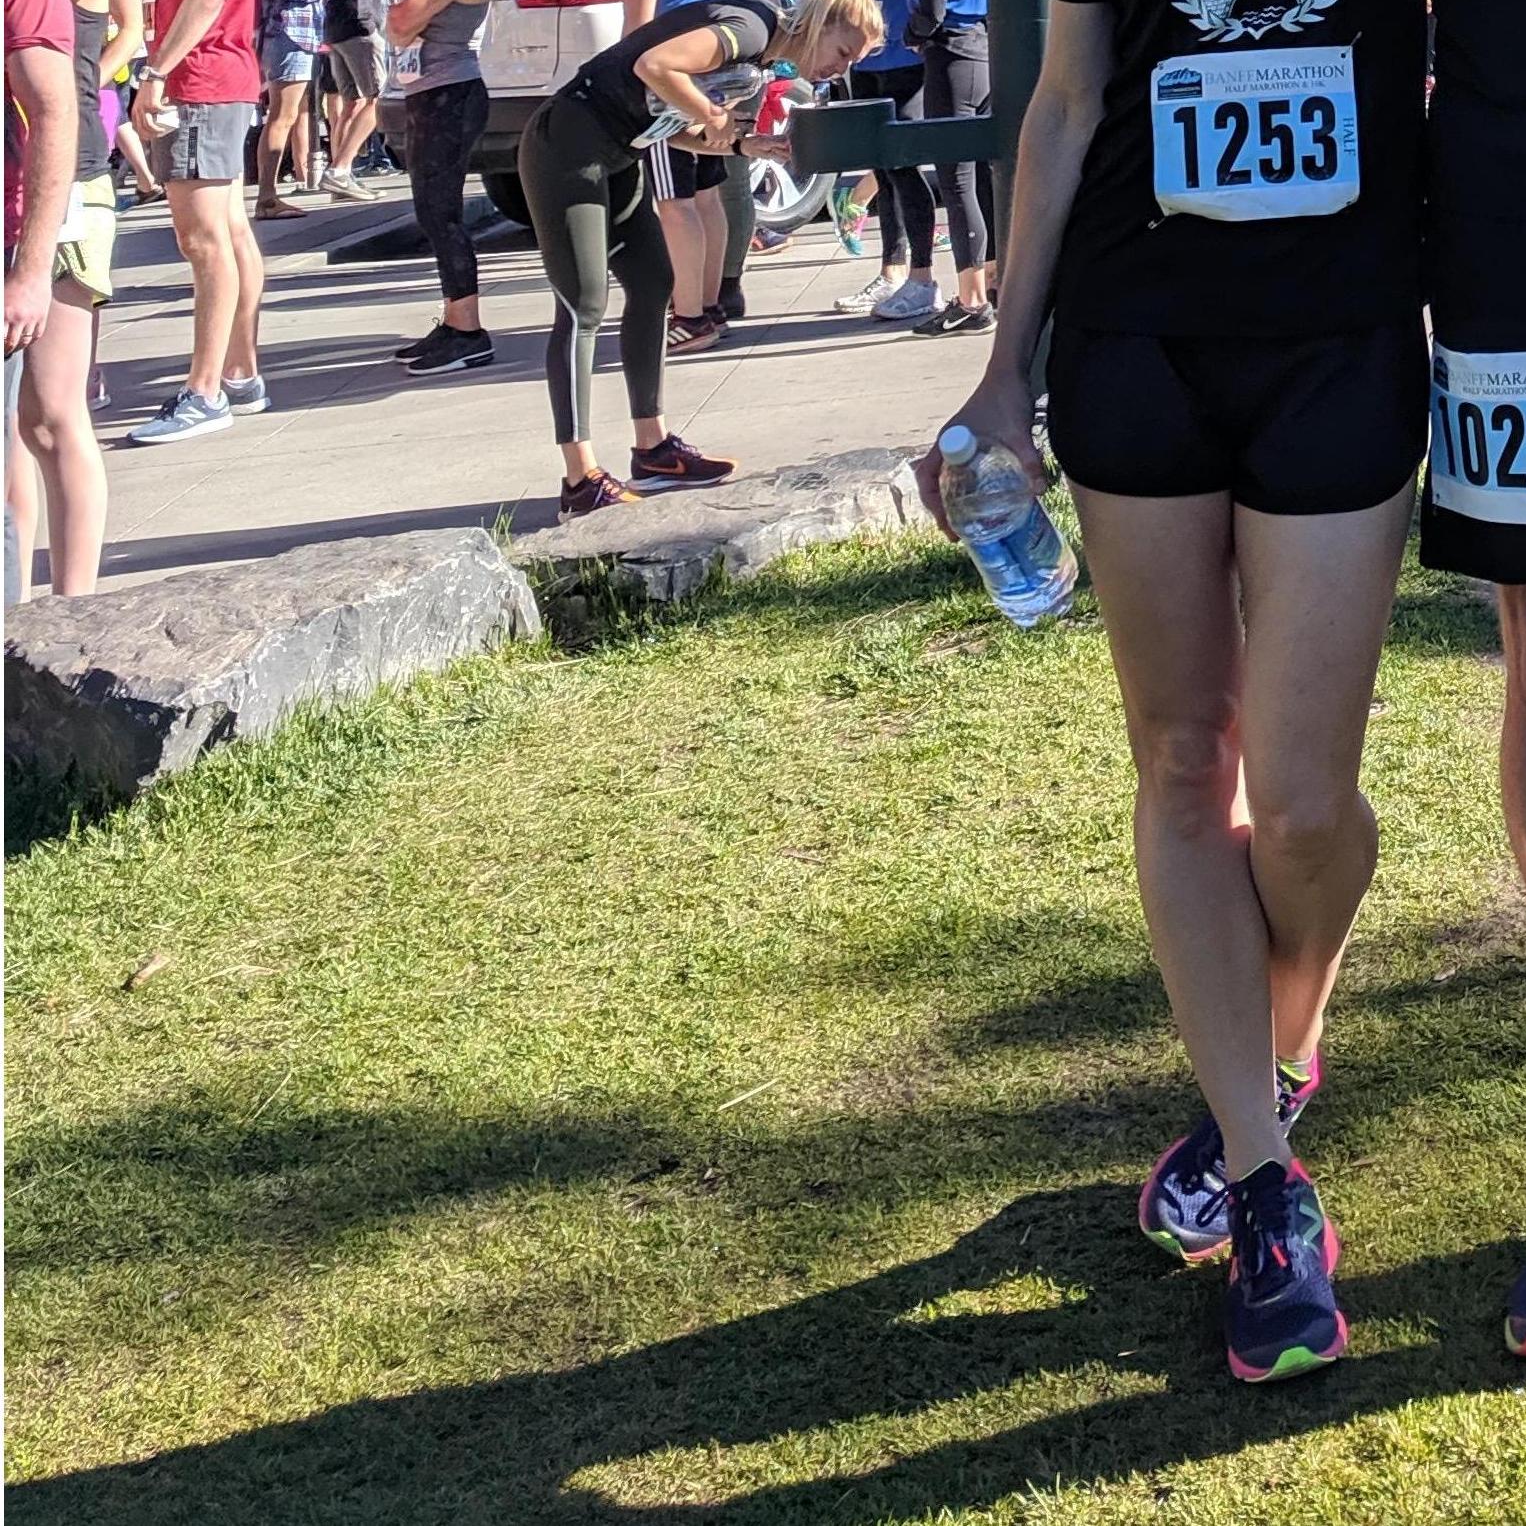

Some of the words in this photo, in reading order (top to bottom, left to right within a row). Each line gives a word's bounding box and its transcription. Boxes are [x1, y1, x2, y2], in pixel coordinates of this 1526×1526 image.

[1224, 83, 1248, 93] HALF
[1250, 80, 1299, 92] MARATHON
[1173, 95, 1339, 190] 1253
[1343, 117, 1356, 157] HALF
